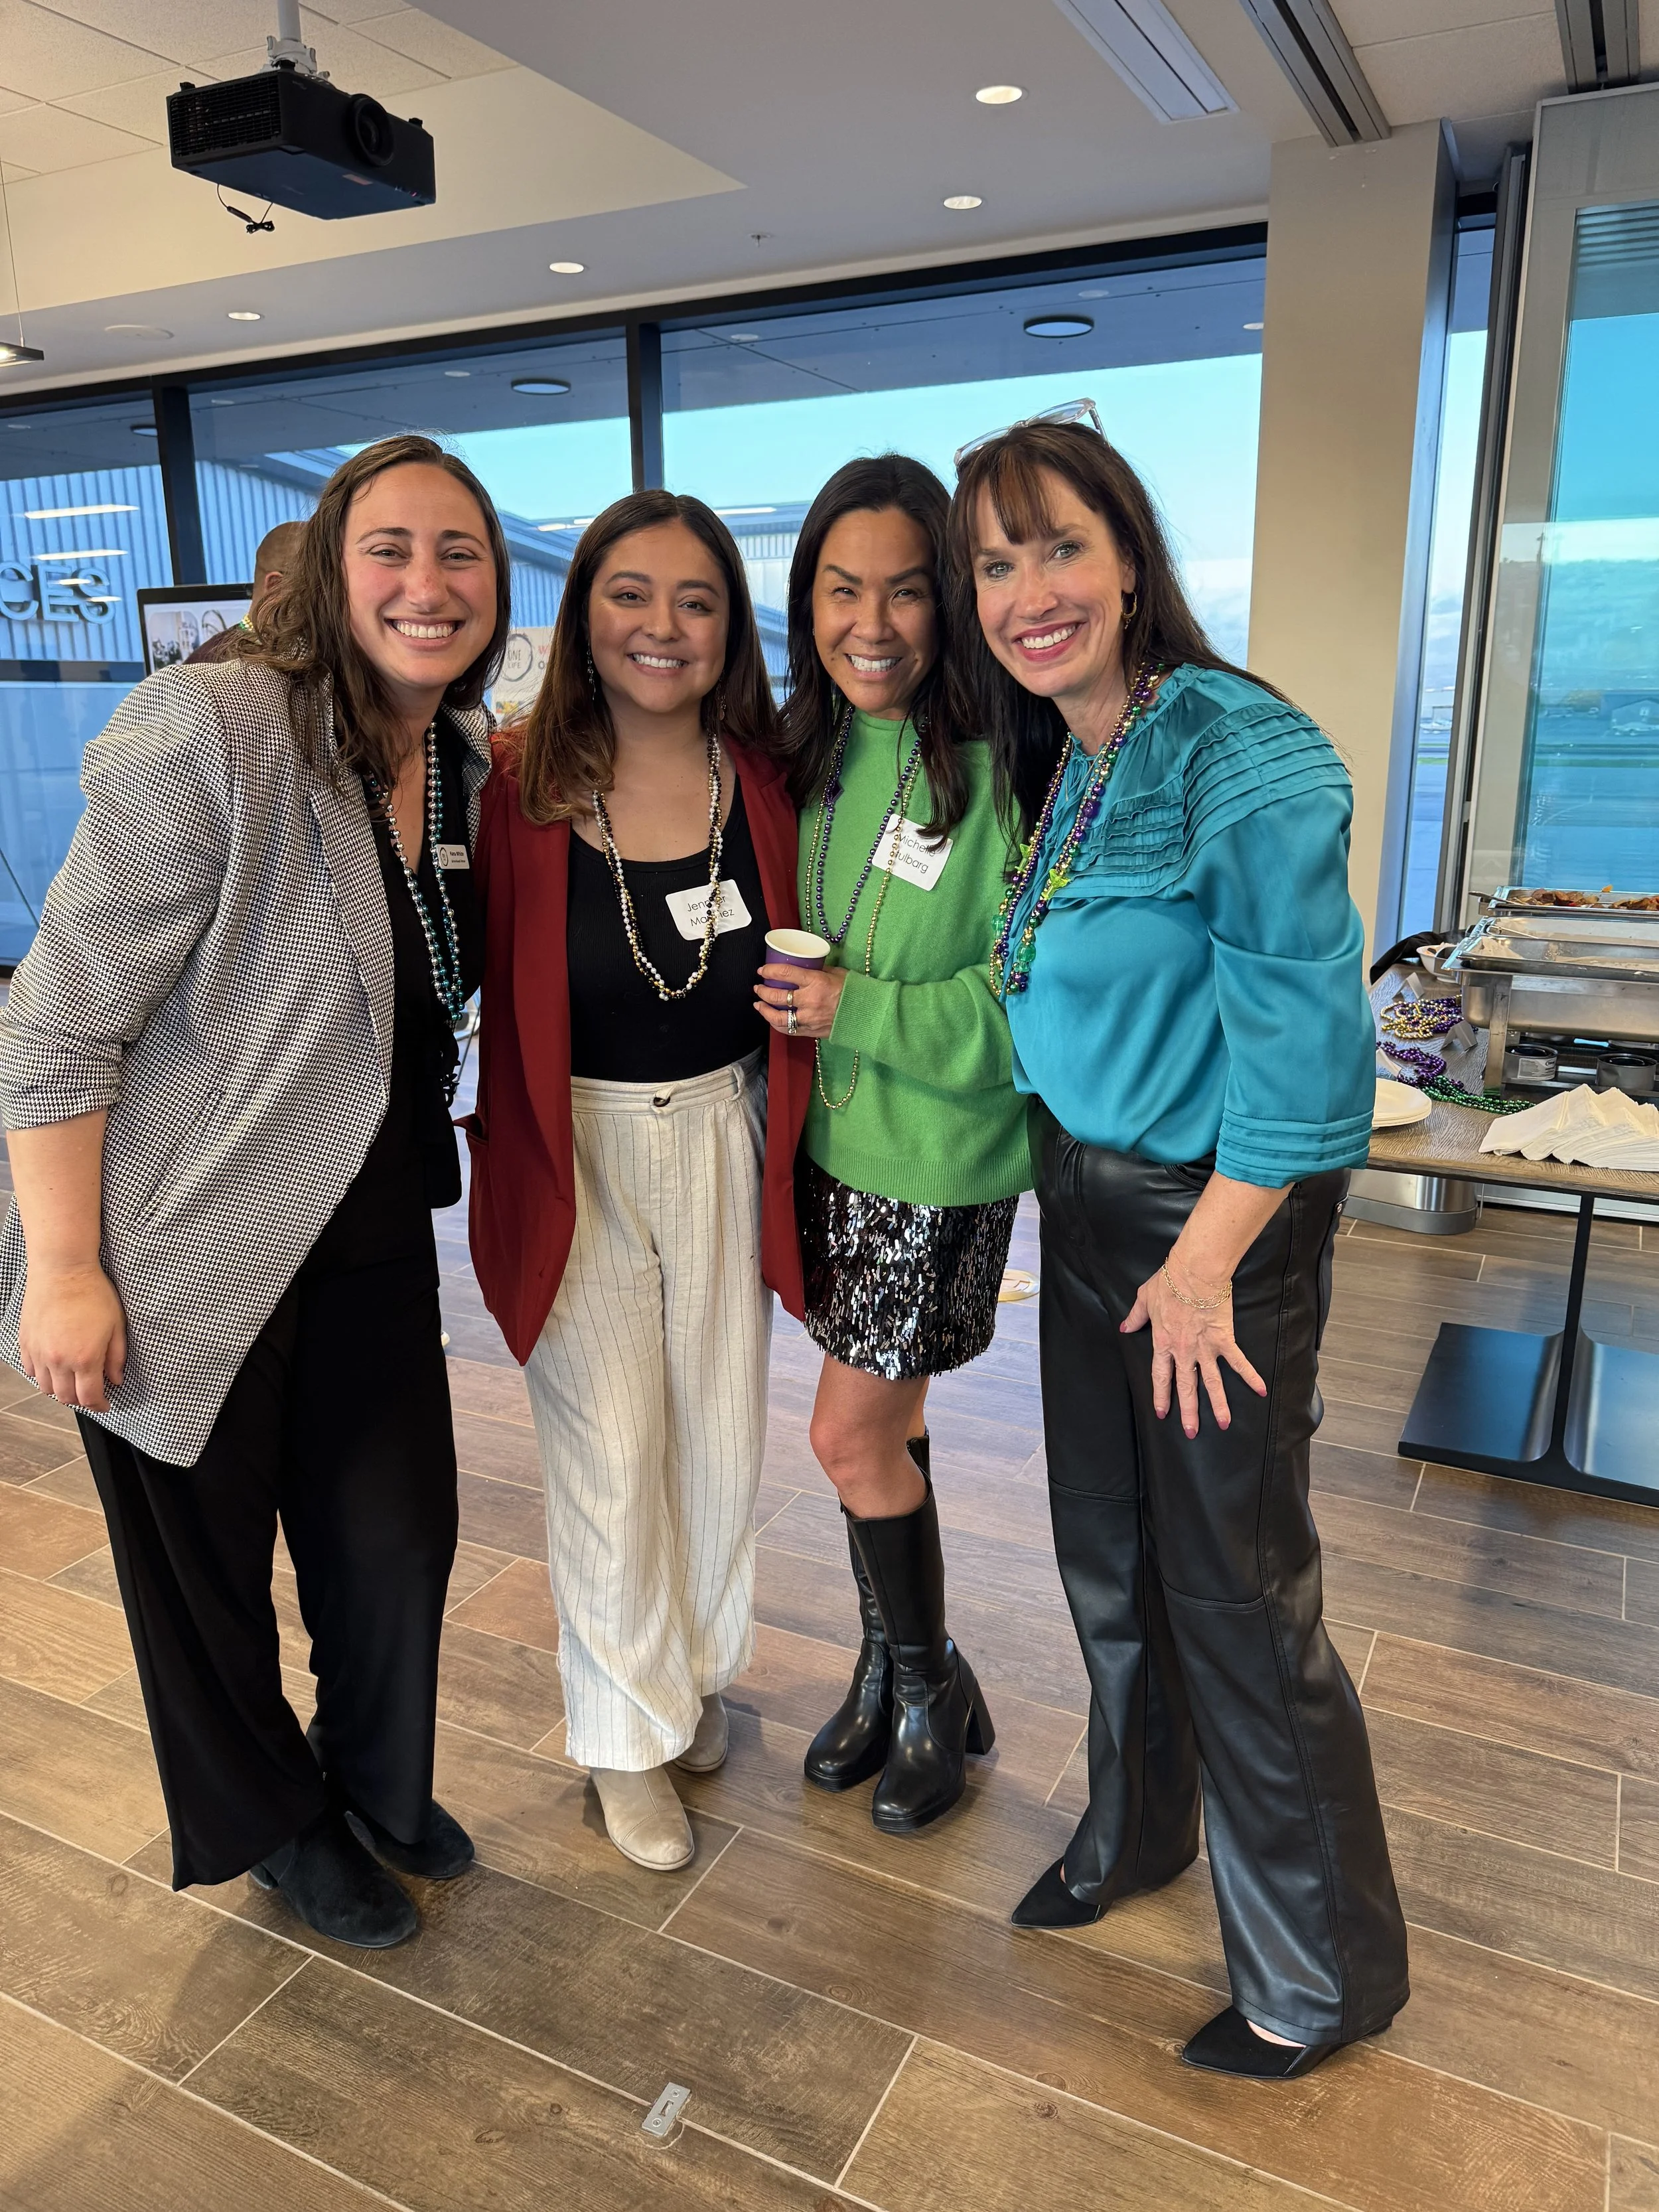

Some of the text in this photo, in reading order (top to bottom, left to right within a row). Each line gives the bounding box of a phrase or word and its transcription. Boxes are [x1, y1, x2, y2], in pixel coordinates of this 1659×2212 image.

[0, 561, 115, 625] CES
[898, 834, 936, 857] Michelle
[895, 849, 929, 874] tulbarg
[687, 896, 725, 912] Jennr
